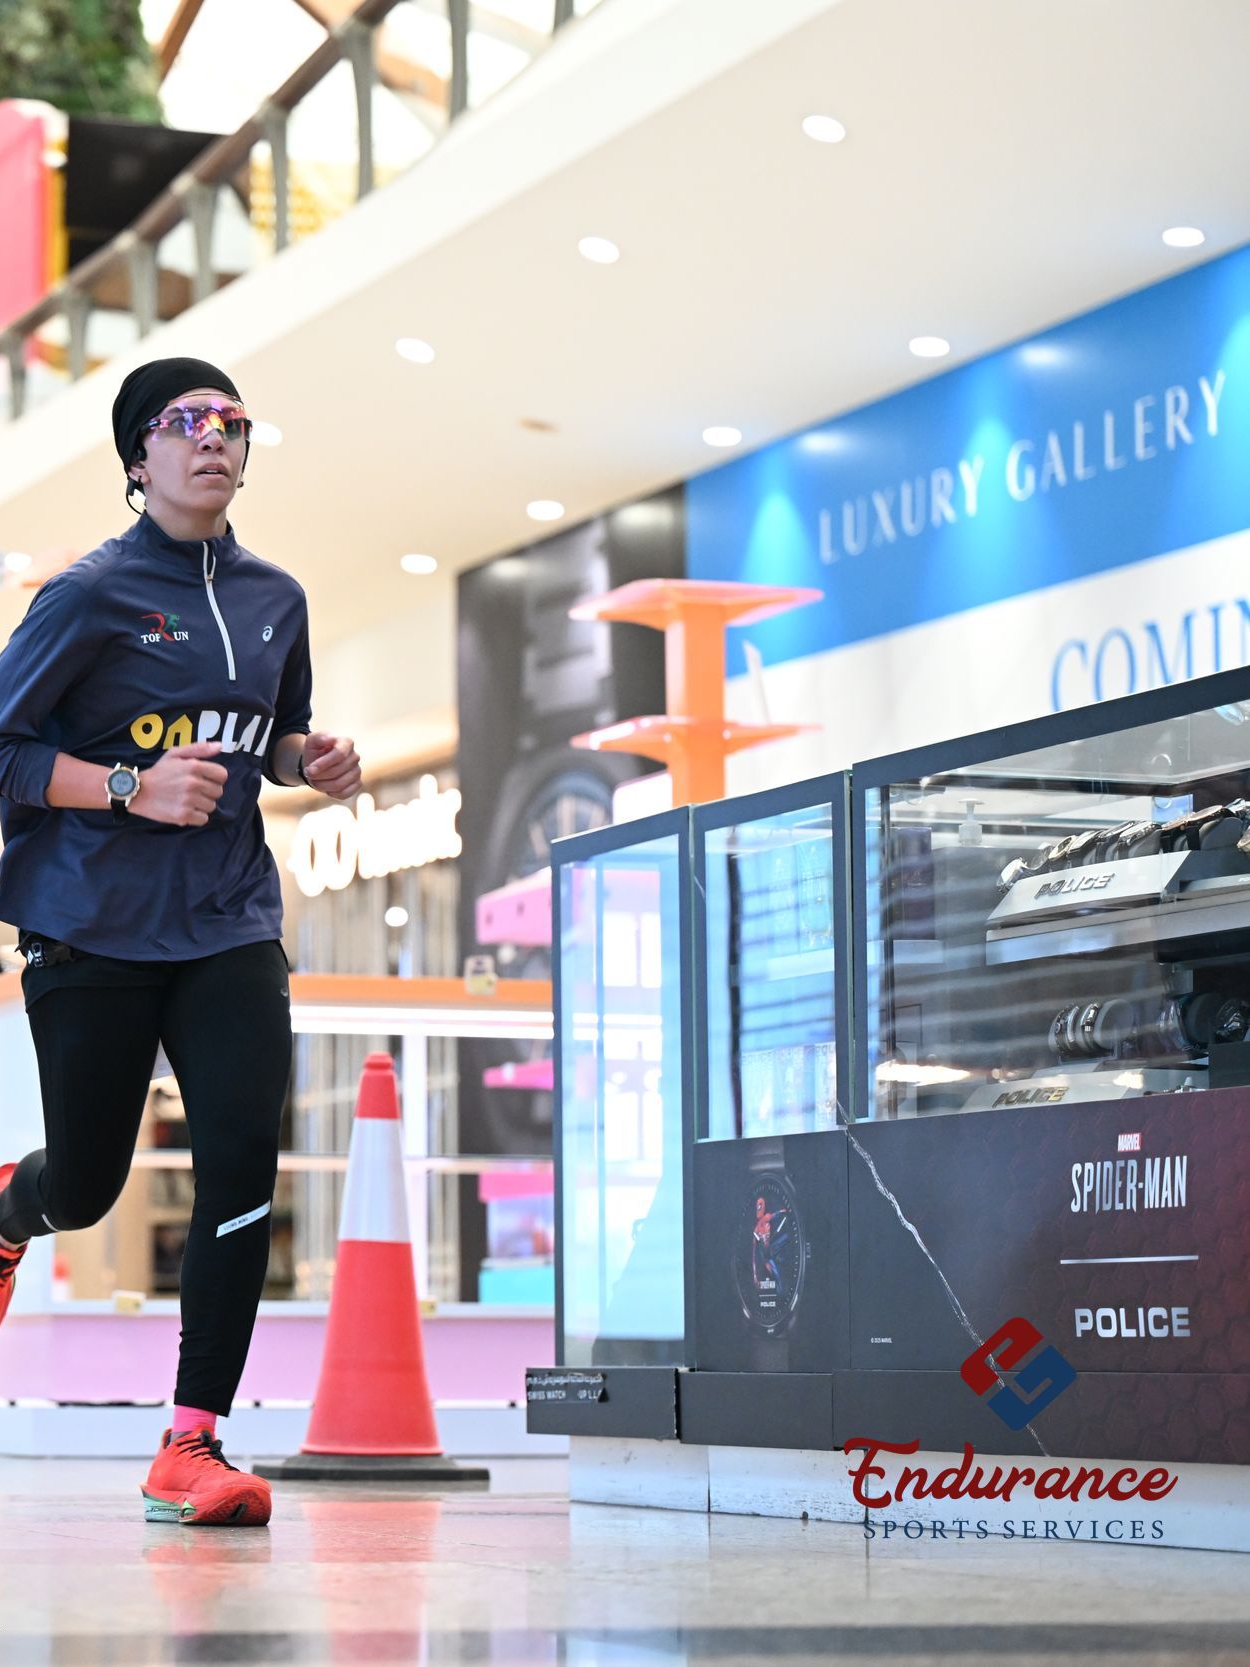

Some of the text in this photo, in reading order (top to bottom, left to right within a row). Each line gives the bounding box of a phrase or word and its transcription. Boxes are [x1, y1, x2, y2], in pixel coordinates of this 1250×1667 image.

[818, 368, 1226, 565] LUXURY GALLERY
[1033, 873, 1115, 900] POLICE
[992, 1087, 1070, 1109] POLICE
[1118, 1133, 1141, 1152] MARVEL
[1070, 1155, 1187, 1214] SPIDER-MAN
[1074, 1307, 1191, 1338] POLICE
